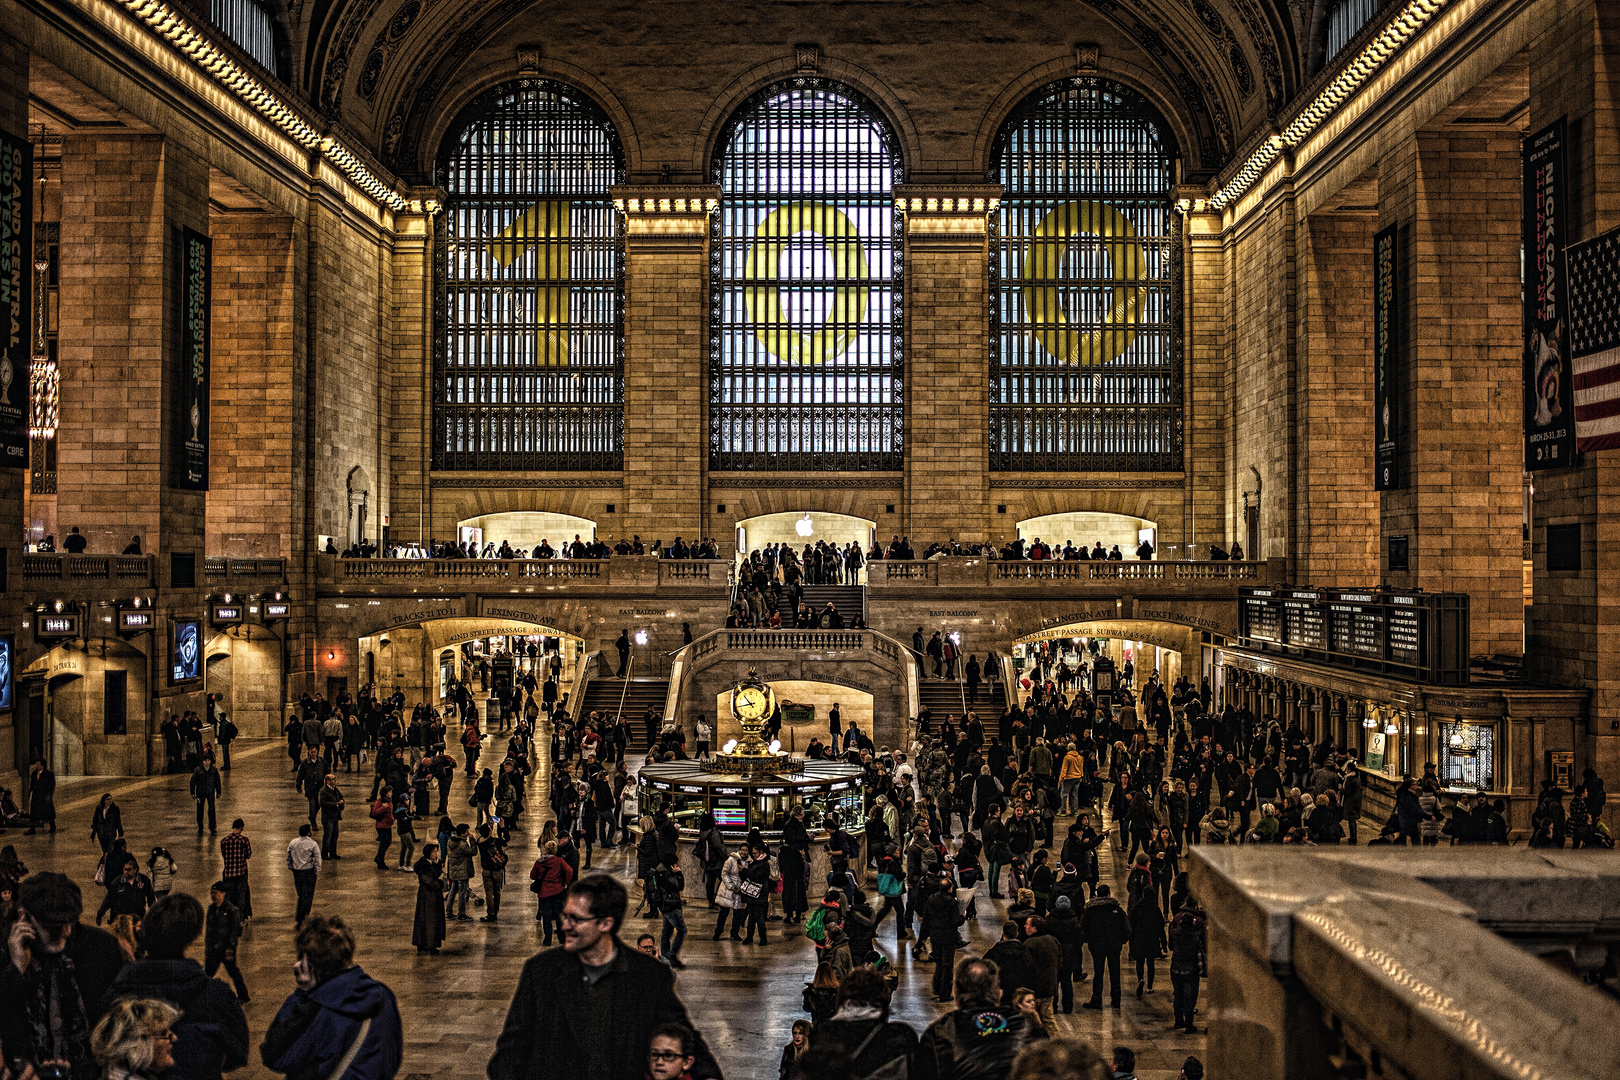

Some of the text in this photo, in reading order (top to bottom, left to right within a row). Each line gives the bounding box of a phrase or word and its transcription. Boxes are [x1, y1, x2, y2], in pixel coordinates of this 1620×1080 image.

[1549, 141, 1560, 151] Transit
[0, 143, 12, 303] 100 YEARS IN
[10, 148, 22, 348] GRAND CENTRAL
[1546, 162, 1556, 320] NICK CAVE
[194, 318, 199, 340] US
[1530, 433, 1542, 443] MARCH
[1556, 428, 1566, 439] 2013
[6, 446, 24, 456] CBRE
[392, 611, 425, 623] TRACKS
[486, 608, 556, 625] LEXINGTON AVE
[1042, 612, 1093, 627] LEXINGTON
[1144, 610, 1220, 629] TICKET MACHINES
[450, 632, 468, 640] 42ND
[470, 628, 496, 637] STREET
[1033, 630, 1060, 639] STREET
[1096, 629, 1128, 637] SUBWAY
[836, 677, 870, 690] CONCOURSE
